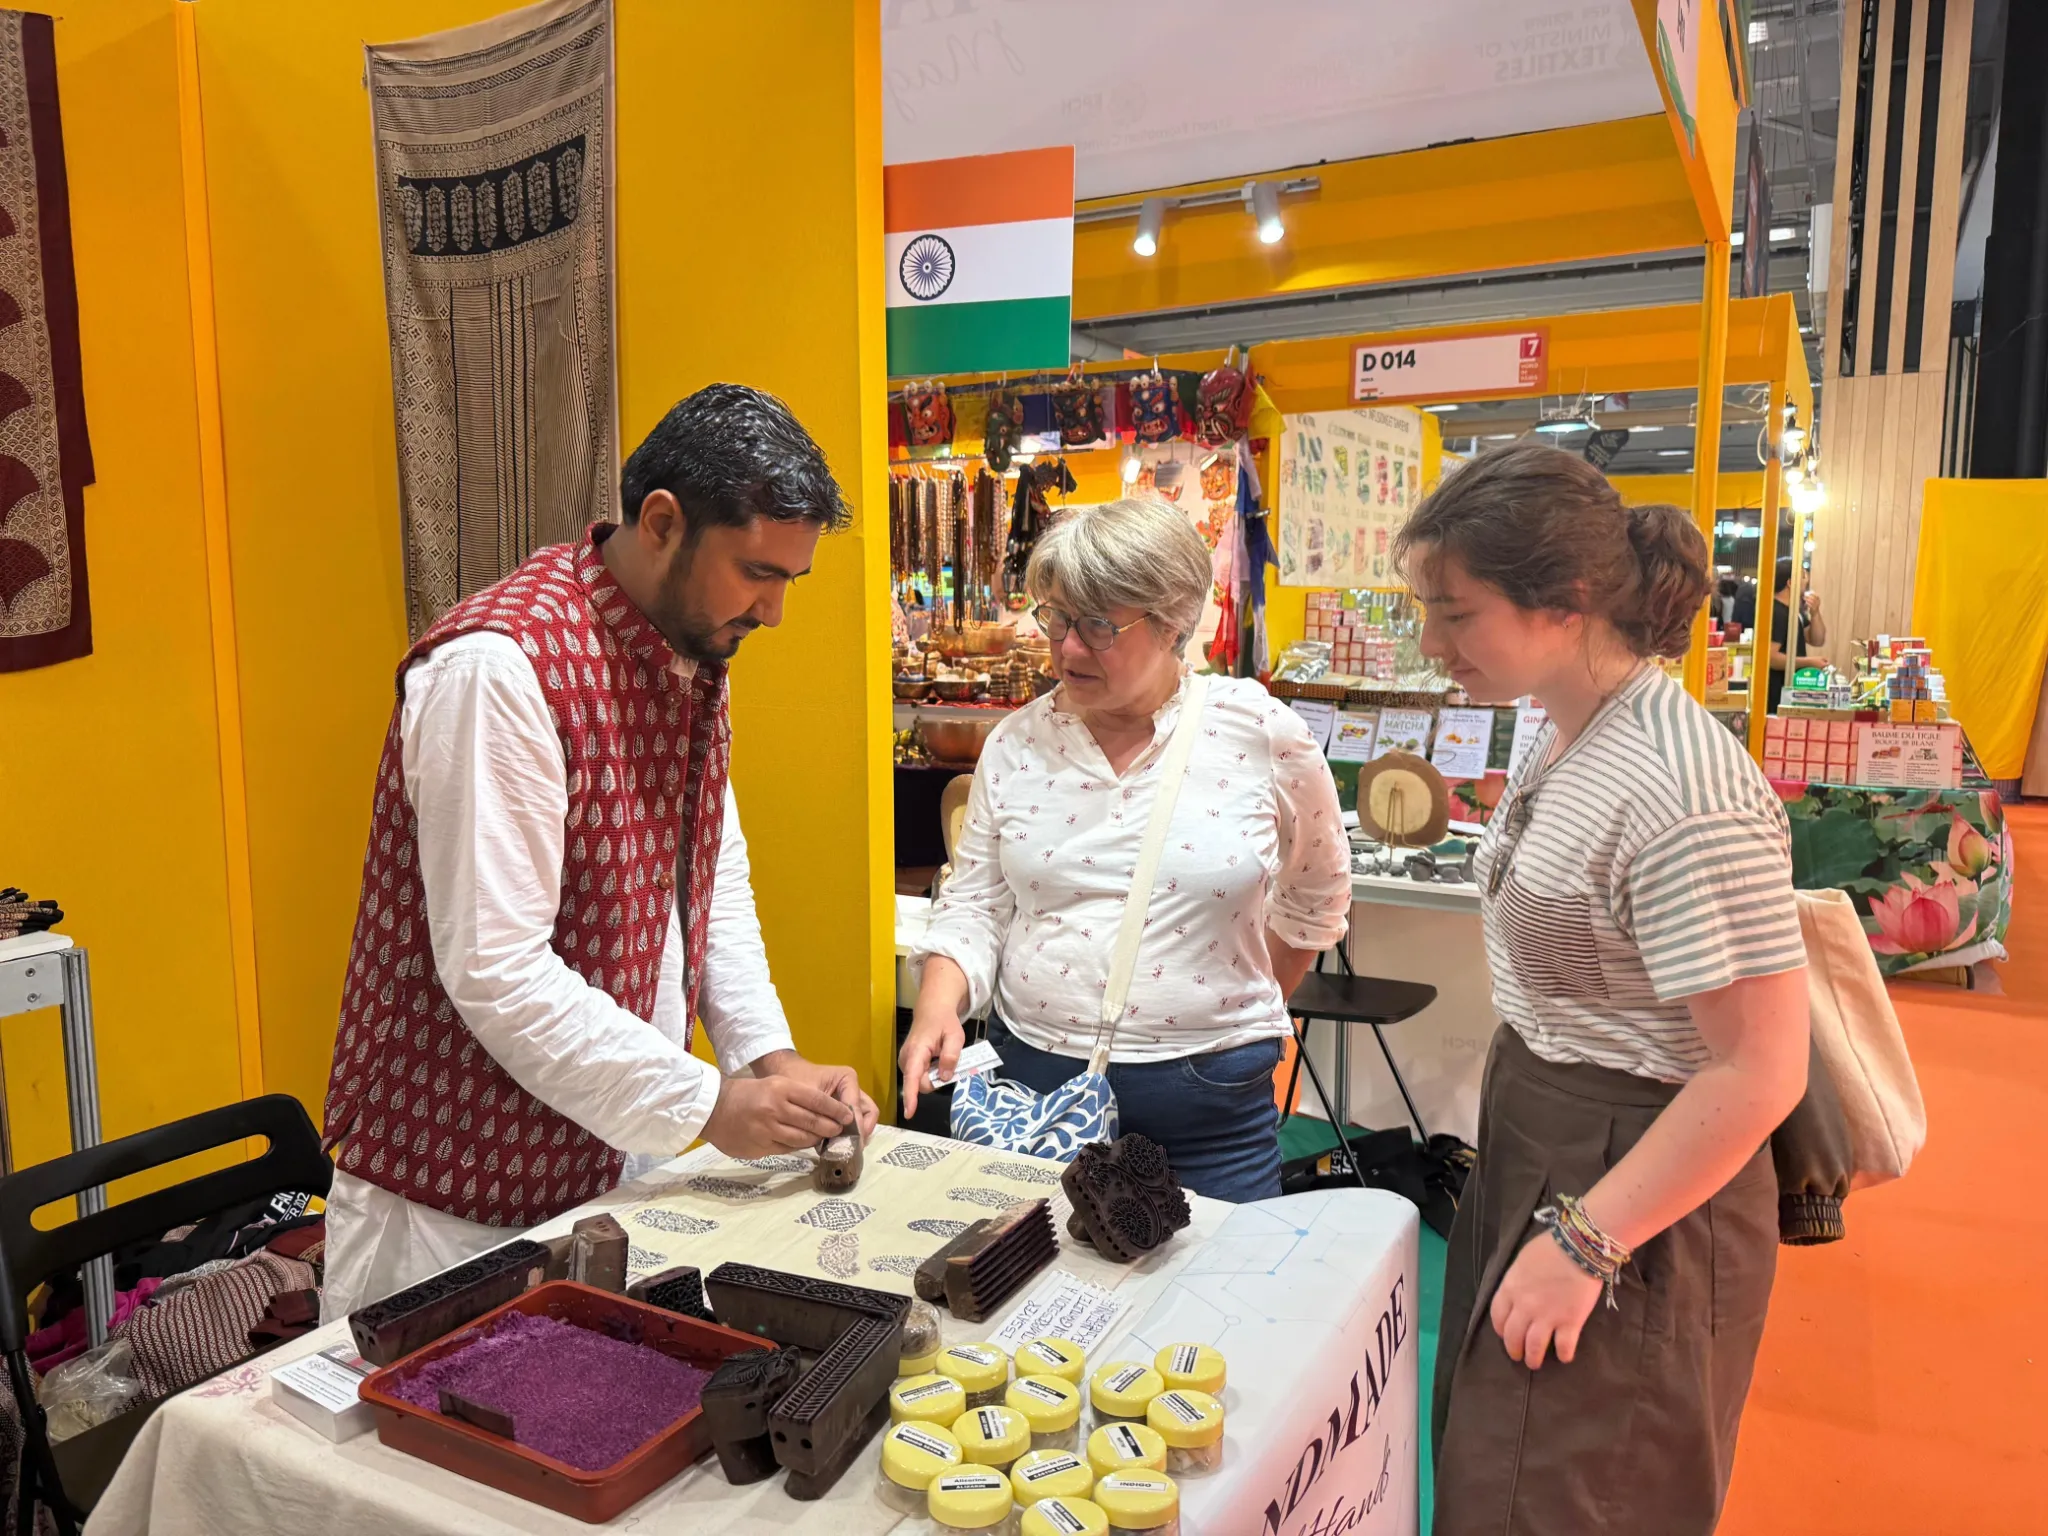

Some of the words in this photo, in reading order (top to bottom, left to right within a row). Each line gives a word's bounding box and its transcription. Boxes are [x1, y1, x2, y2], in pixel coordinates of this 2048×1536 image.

[1528, 339, 1540, 356] 7
[1362, 353, 1377, 372] D
[1381, 350, 1416, 371] 014
[1384, 720, 1425, 731] MATCHA
[1523, 716, 1540, 724] GIN
[1872, 731, 1898, 739] BAUME
[1901, 731, 1915, 739] DU
[1918, 732, 1941, 740] TIGRE
[1262, 1273, 1407, 1536] NDMADE
